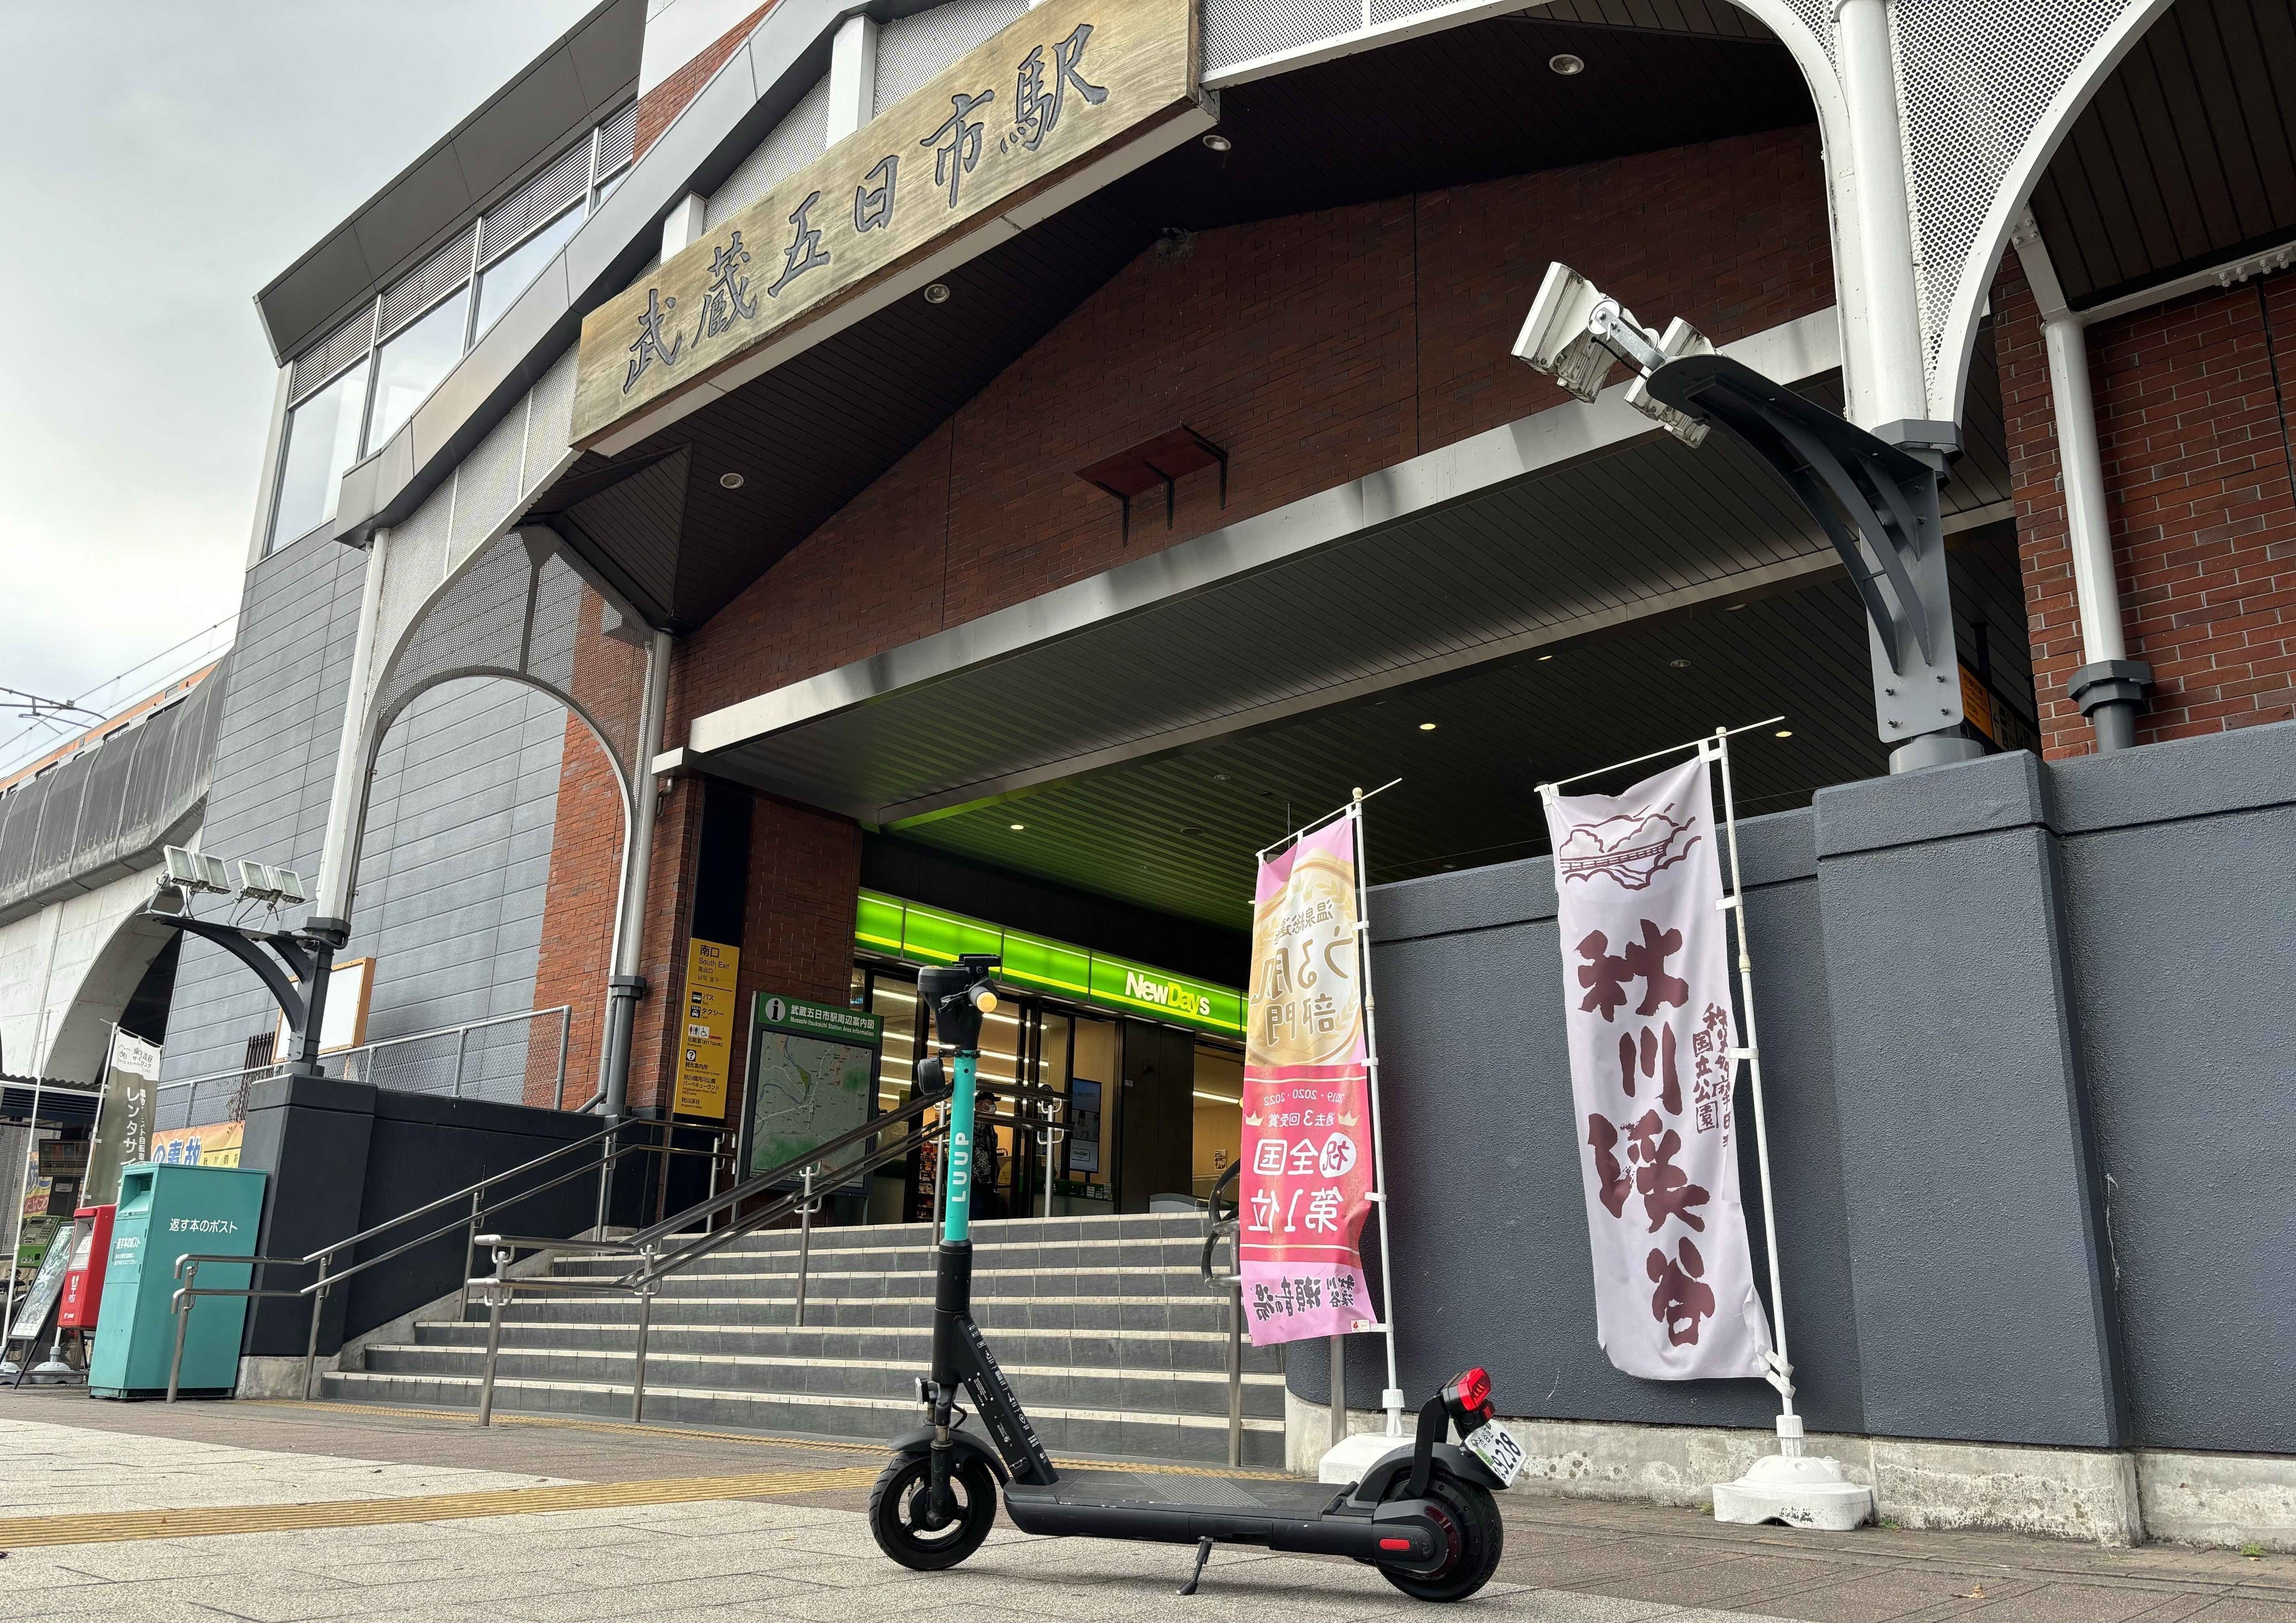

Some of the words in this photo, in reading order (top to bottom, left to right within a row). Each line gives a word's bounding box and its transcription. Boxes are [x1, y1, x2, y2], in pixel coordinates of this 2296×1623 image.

[623, 24, 1109, 394] 武蔵五日市駅
[699, 957, 716, 967] South
[718, 961, 729, 970] Exit
[700, 944, 720, 958] 南口
[1125, 971, 1210, 1015] NewDays
[702, 1008, 724, 1016] タクシー
[790, 1016, 828, 1028] Musashi-Itsukaichi
[828, 1023, 842, 1031] Station
[852, 1027, 875, 1037] Information
[791, 1004, 875, 1030] 武蔵五日市駅周辺案内図
[1693, 1030, 1719, 1134] 国立公園
[1703, 1002, 1731, 1147] 秩父多摩
[1574, 918, 1716, 1347] 秋川渓谷
[951, 1132, 969, 1202] LUUP
[169, 1217, 238, 1234] 返す本のポスト
[1475, 1428, 1494, 1449] 渋谷区
[1491, 1432, 1521, 1475] 9238
